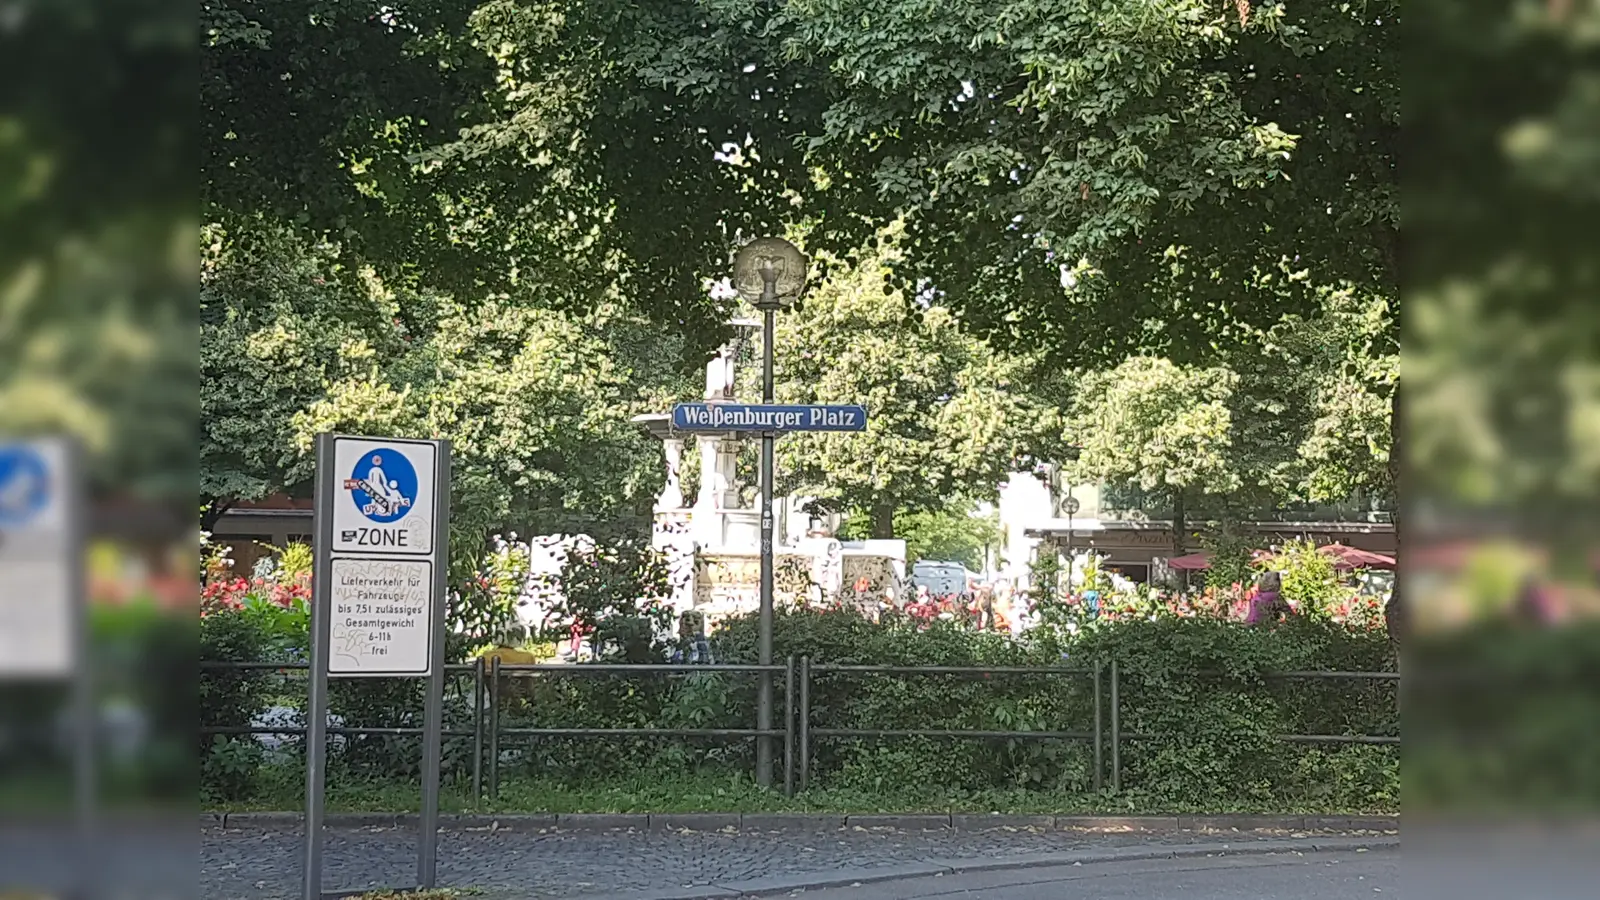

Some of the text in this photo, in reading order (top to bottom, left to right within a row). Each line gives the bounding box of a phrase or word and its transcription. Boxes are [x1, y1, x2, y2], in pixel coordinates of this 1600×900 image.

[683, 405, 855, 428] Weißenburger Platz
[358, 528, 408, 547] ZONE
[341, 576, 421, 587] Lieferverkehr für
[357, 590, 405, 602] Fahrzeuge
[338, 604, 352, 614] bis
[375, 605, 422, 616] zulässiges
[345, 618, 415, 629] Gesamtgewicht
[368, 632, 391, 641] 6-11h
[371, 646, 388, 655] frei
